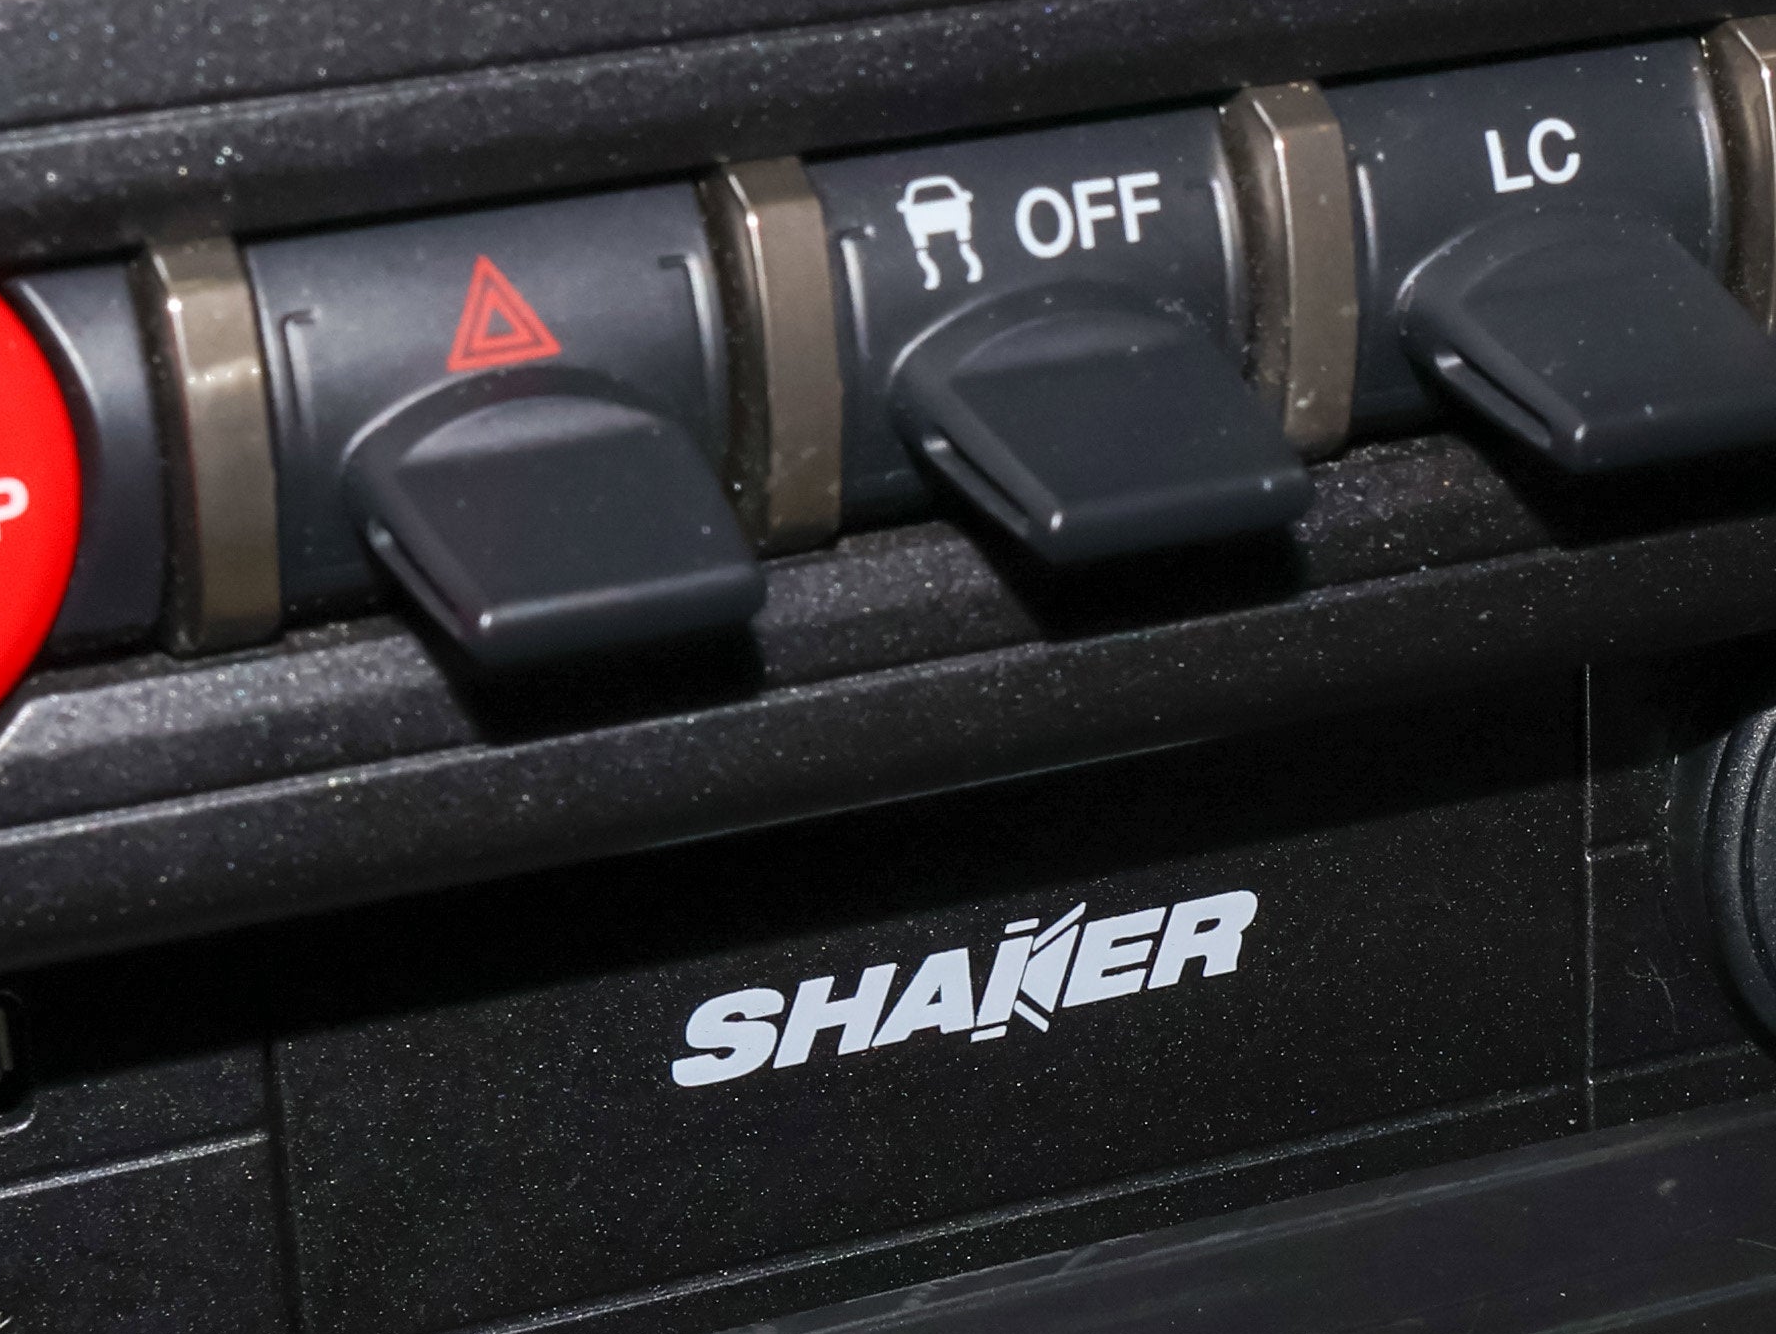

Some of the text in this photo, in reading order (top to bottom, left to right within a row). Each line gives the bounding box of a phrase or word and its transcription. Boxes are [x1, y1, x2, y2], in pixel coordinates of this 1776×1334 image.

[1483, 116, 1582, 195] LC
[1013, 169, 1163, 260] OFF
[670, 889, 1260, 1088] SHAKER
